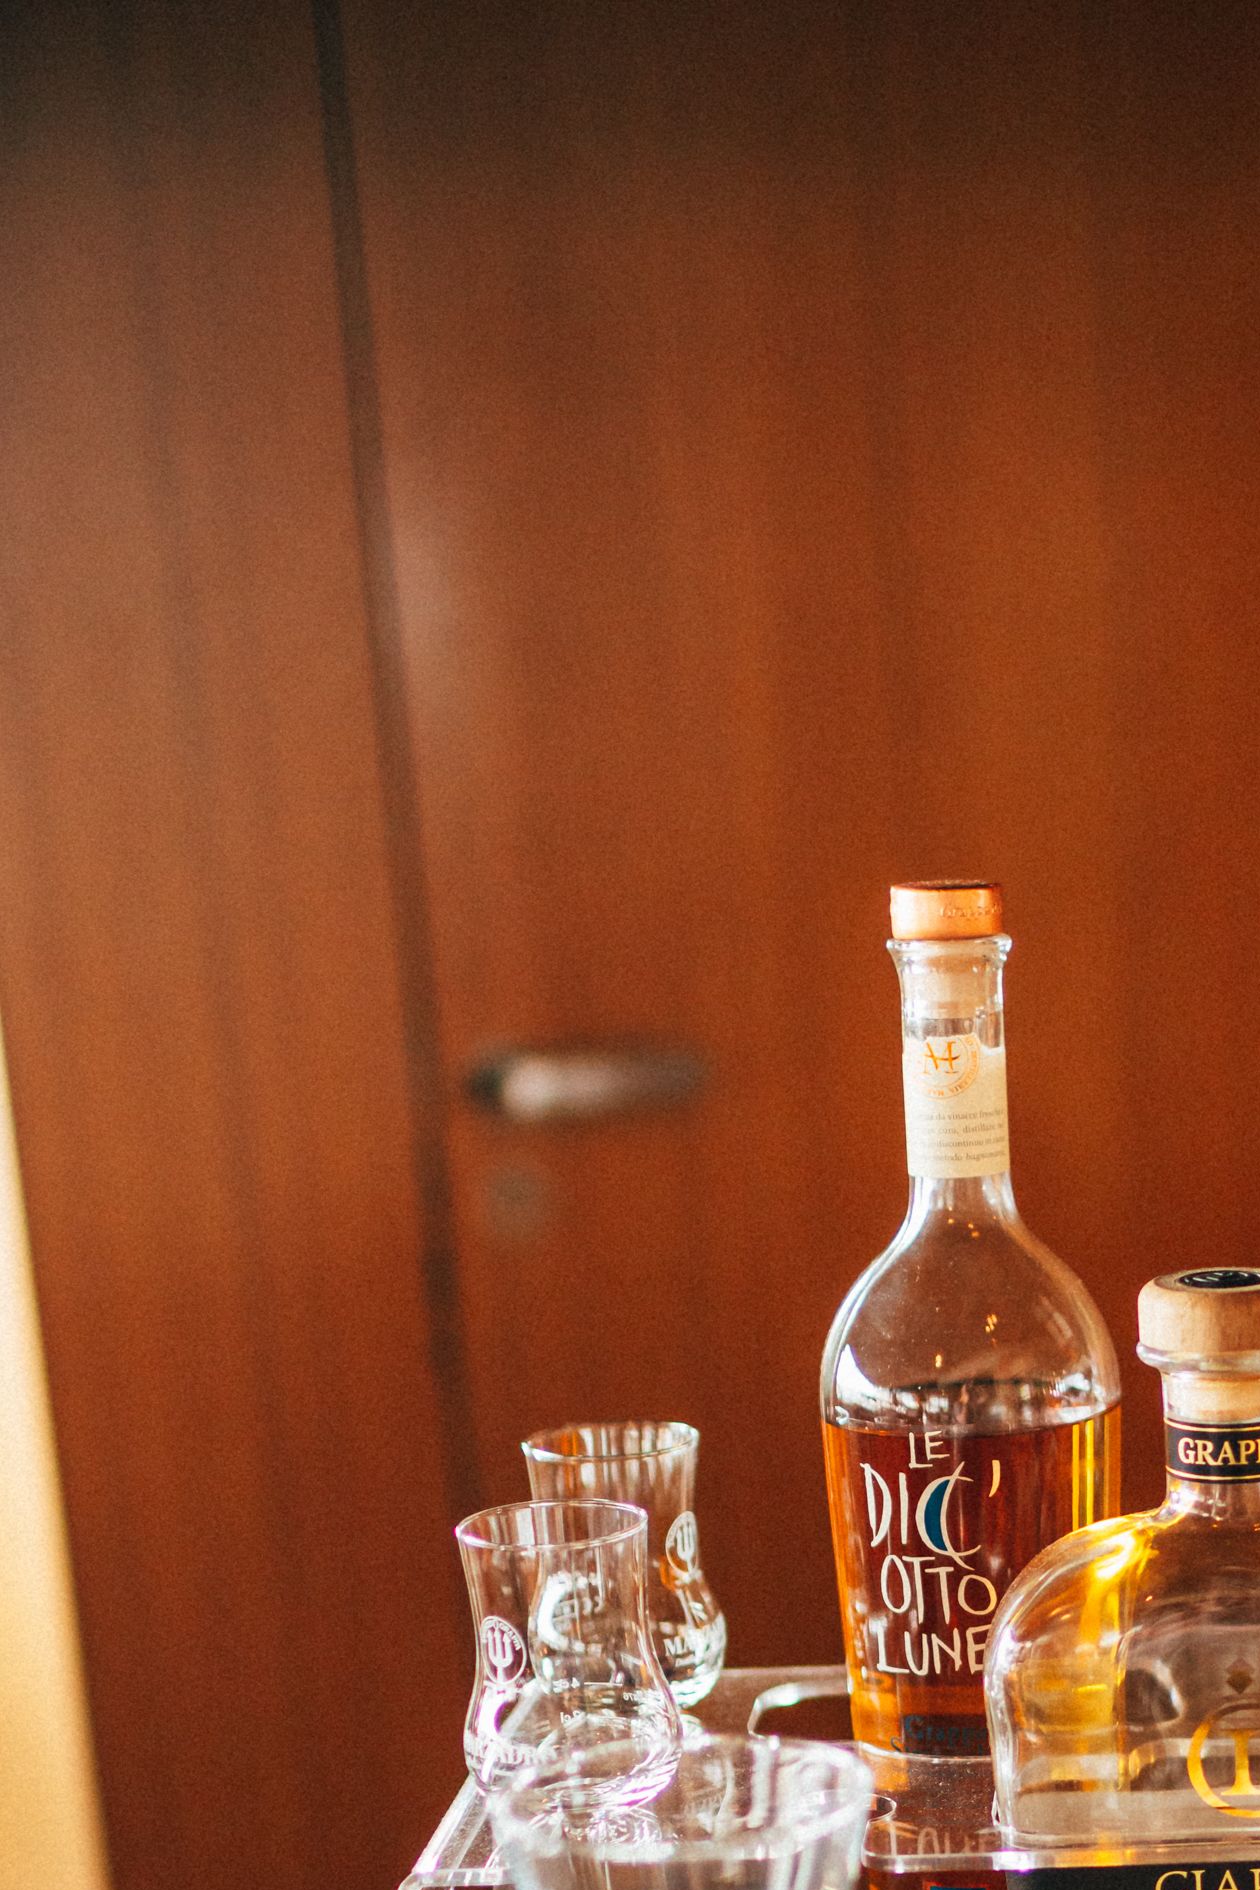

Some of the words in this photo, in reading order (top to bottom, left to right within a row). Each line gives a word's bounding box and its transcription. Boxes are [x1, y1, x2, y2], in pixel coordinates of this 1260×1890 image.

[909, 1431, 950, 1469] LE
[880, 1553, 998, 1625] OTTO
[876, 1623, 993, 1677] LUNE
